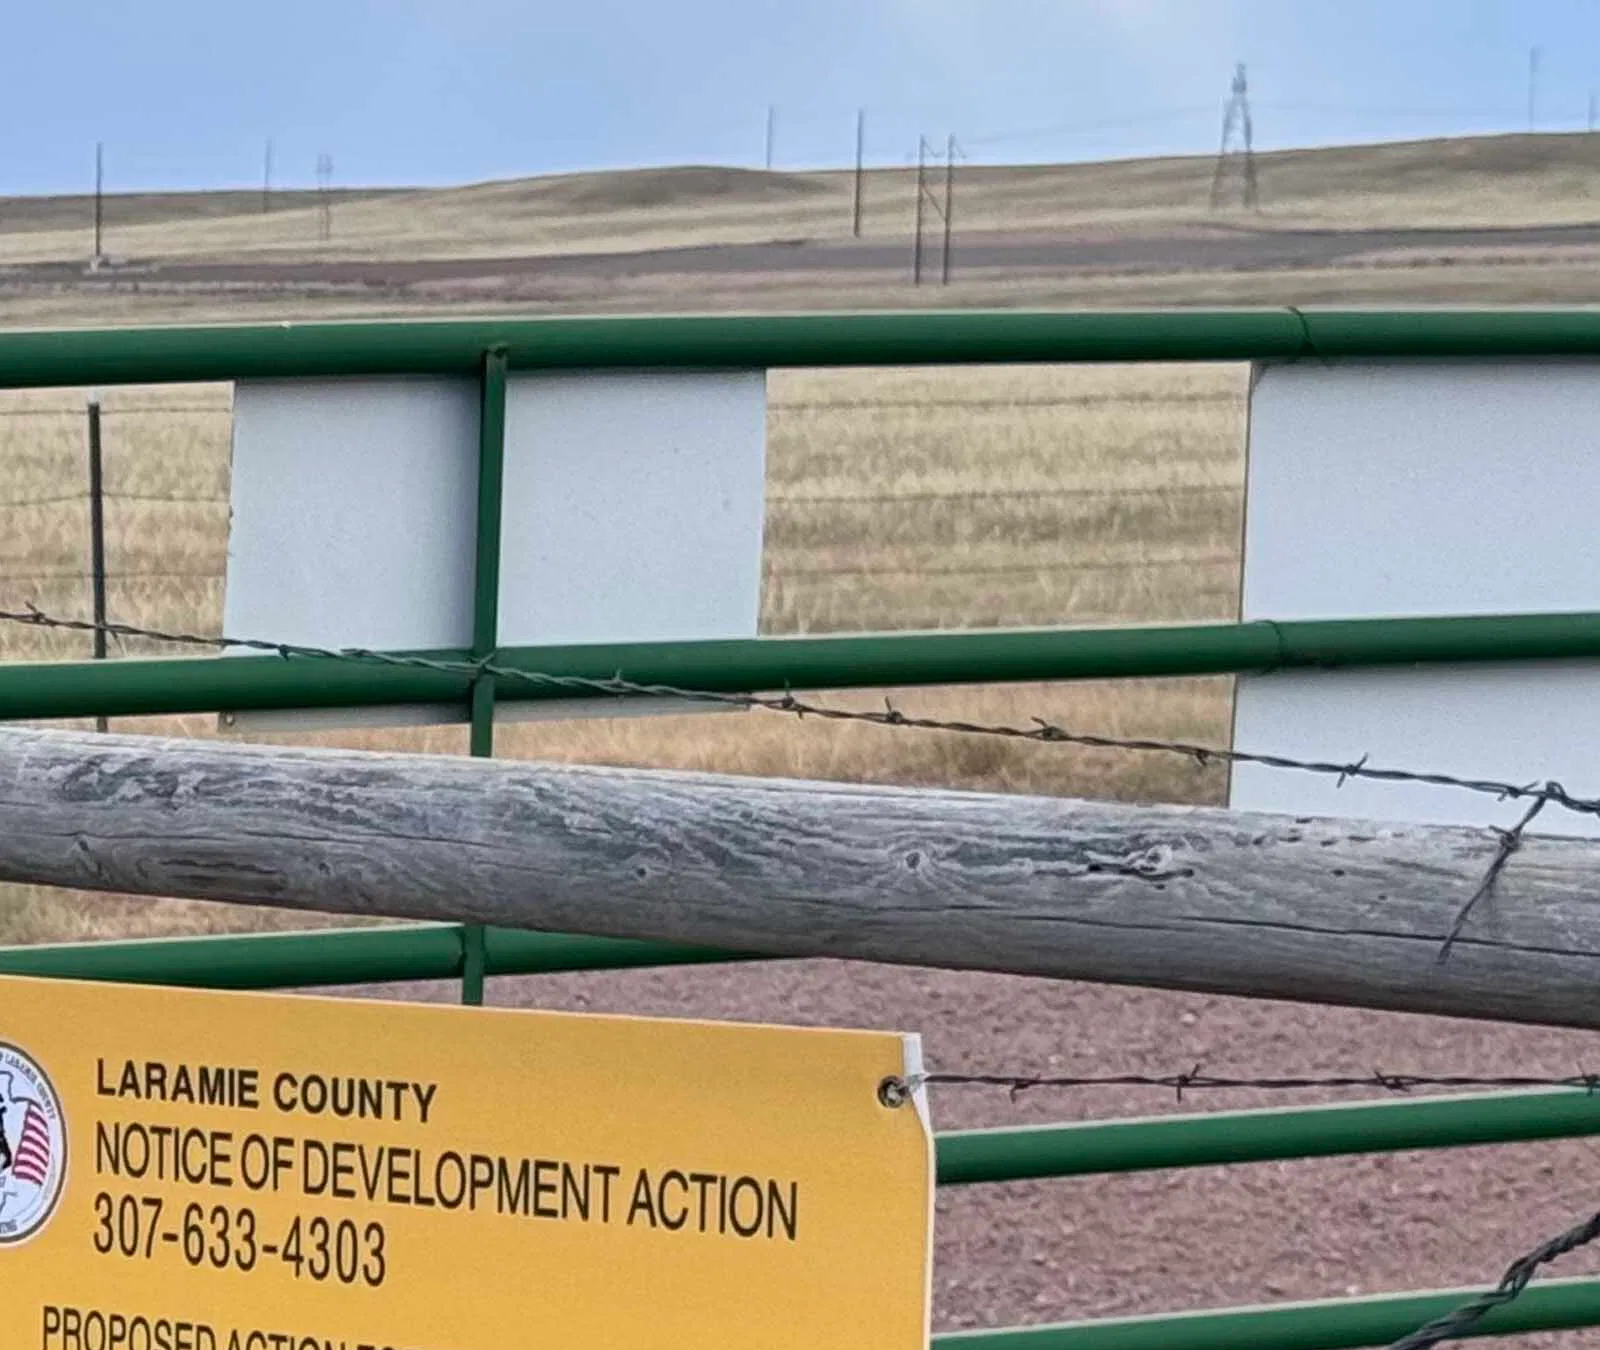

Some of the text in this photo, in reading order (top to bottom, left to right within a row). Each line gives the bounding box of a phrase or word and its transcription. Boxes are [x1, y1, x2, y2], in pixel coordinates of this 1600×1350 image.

[96, 1057, 437, 1123] LARAMIE COUNTY
[95, 1119, 798, 1241] NOTICE OF DEVELOPMENT ACTION
[93, 1191, 386, 1288] 307-633-4303
